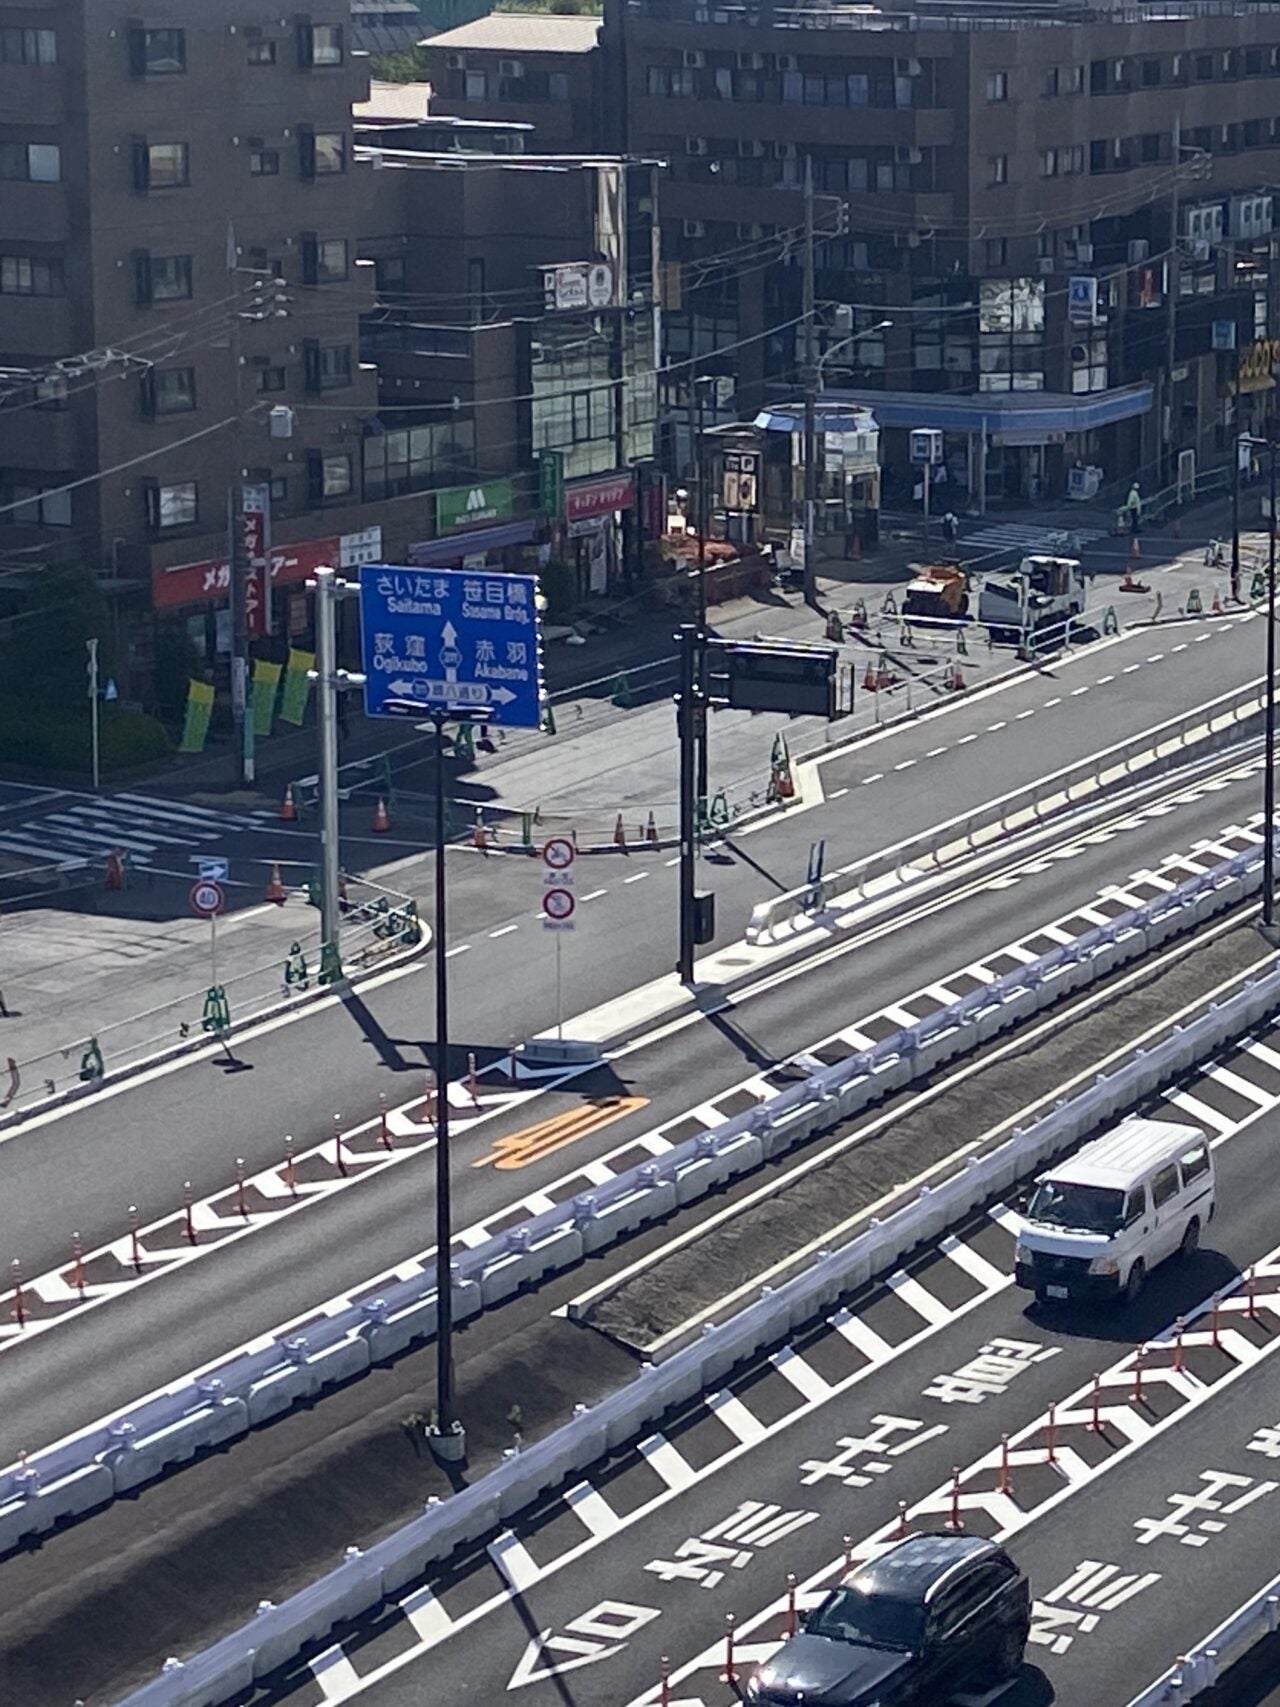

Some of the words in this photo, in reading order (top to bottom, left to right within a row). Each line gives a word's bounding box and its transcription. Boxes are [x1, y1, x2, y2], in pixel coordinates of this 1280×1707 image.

[377, 575, 450, 598] さいたま
[463, 579, 528, 604] 笹目橋
[387, 597, 441, 616] Saitama
[374, 633, 426, 657] 荻窪
[476, 640, 527, 664] 赤羽
[373, 655, 428, 674] Ogikubo
[475, 663, 528, 681] Akabane
